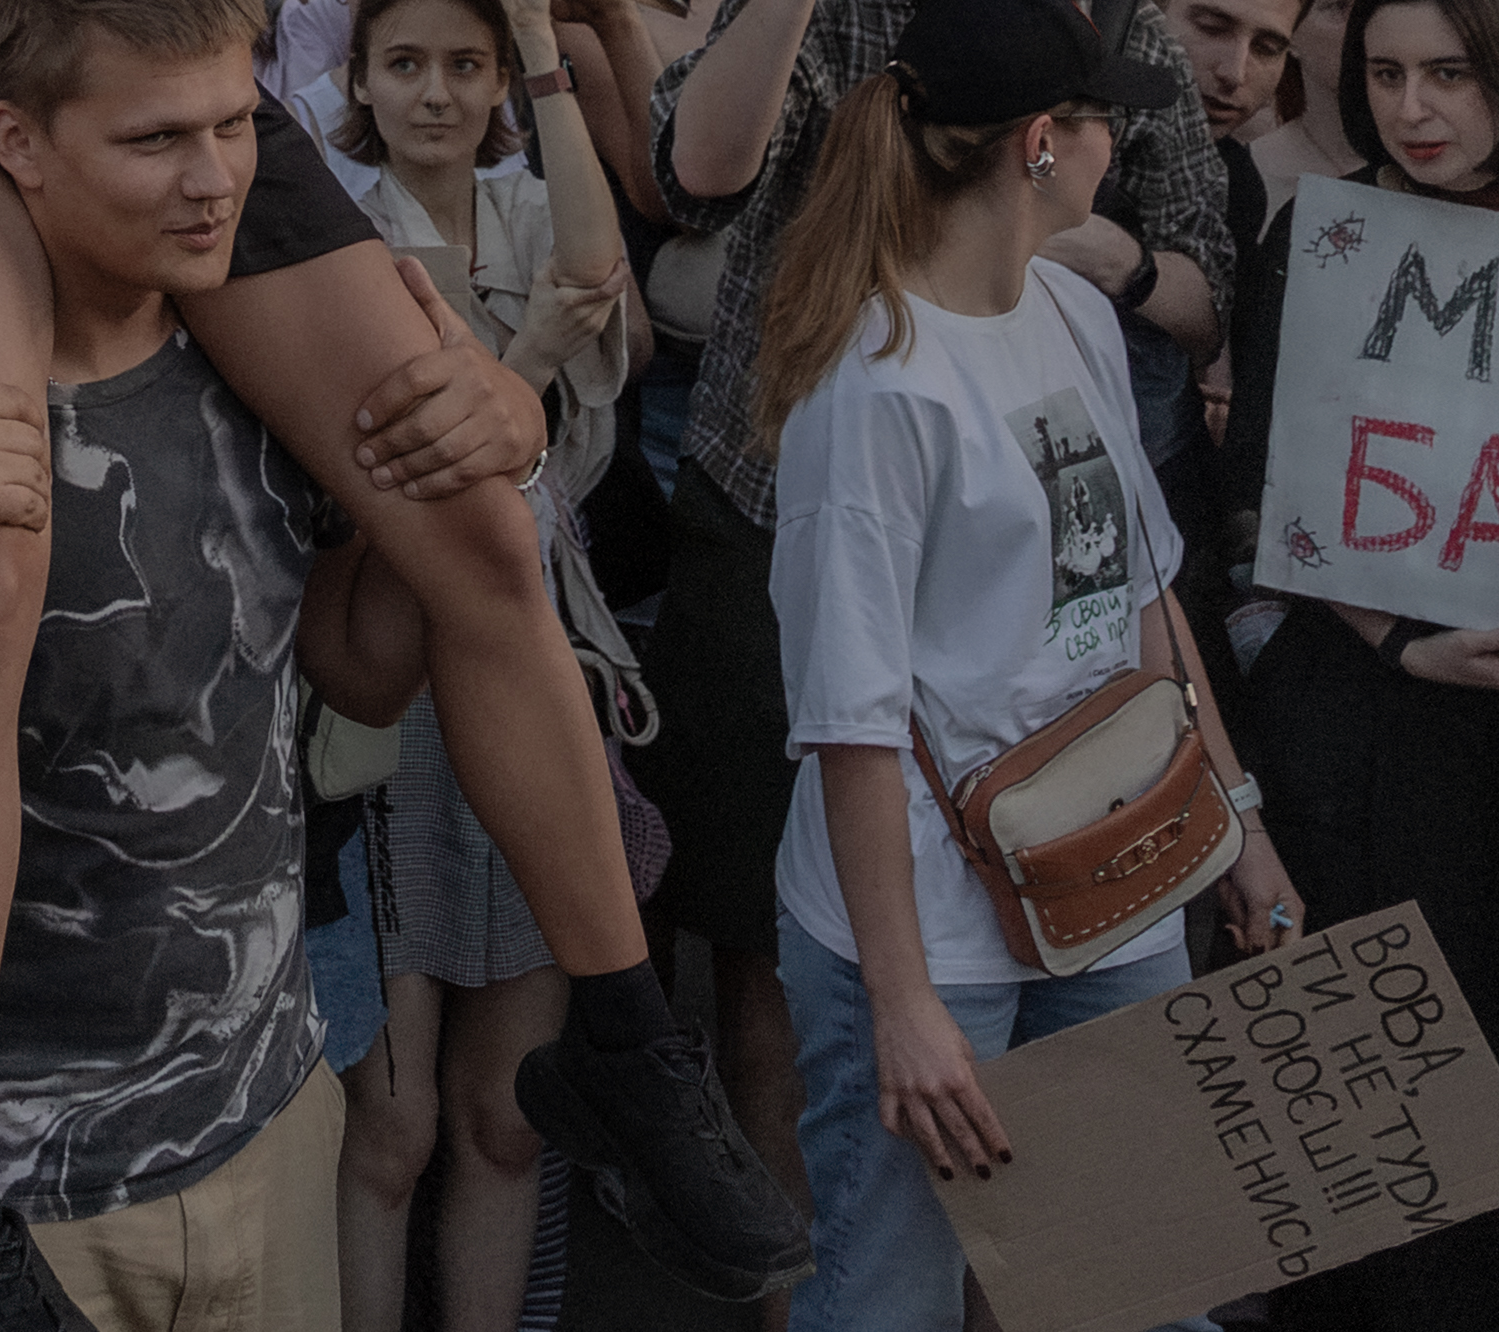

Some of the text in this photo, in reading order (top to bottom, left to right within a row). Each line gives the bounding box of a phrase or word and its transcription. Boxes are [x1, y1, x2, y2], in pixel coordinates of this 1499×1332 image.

[1163, 990, 1313, 1279] СХАМЕНИСЬ
[1291, 932, 1358, 1011] ТИ
[1329, 1033, 1400, 1110] НЕ
